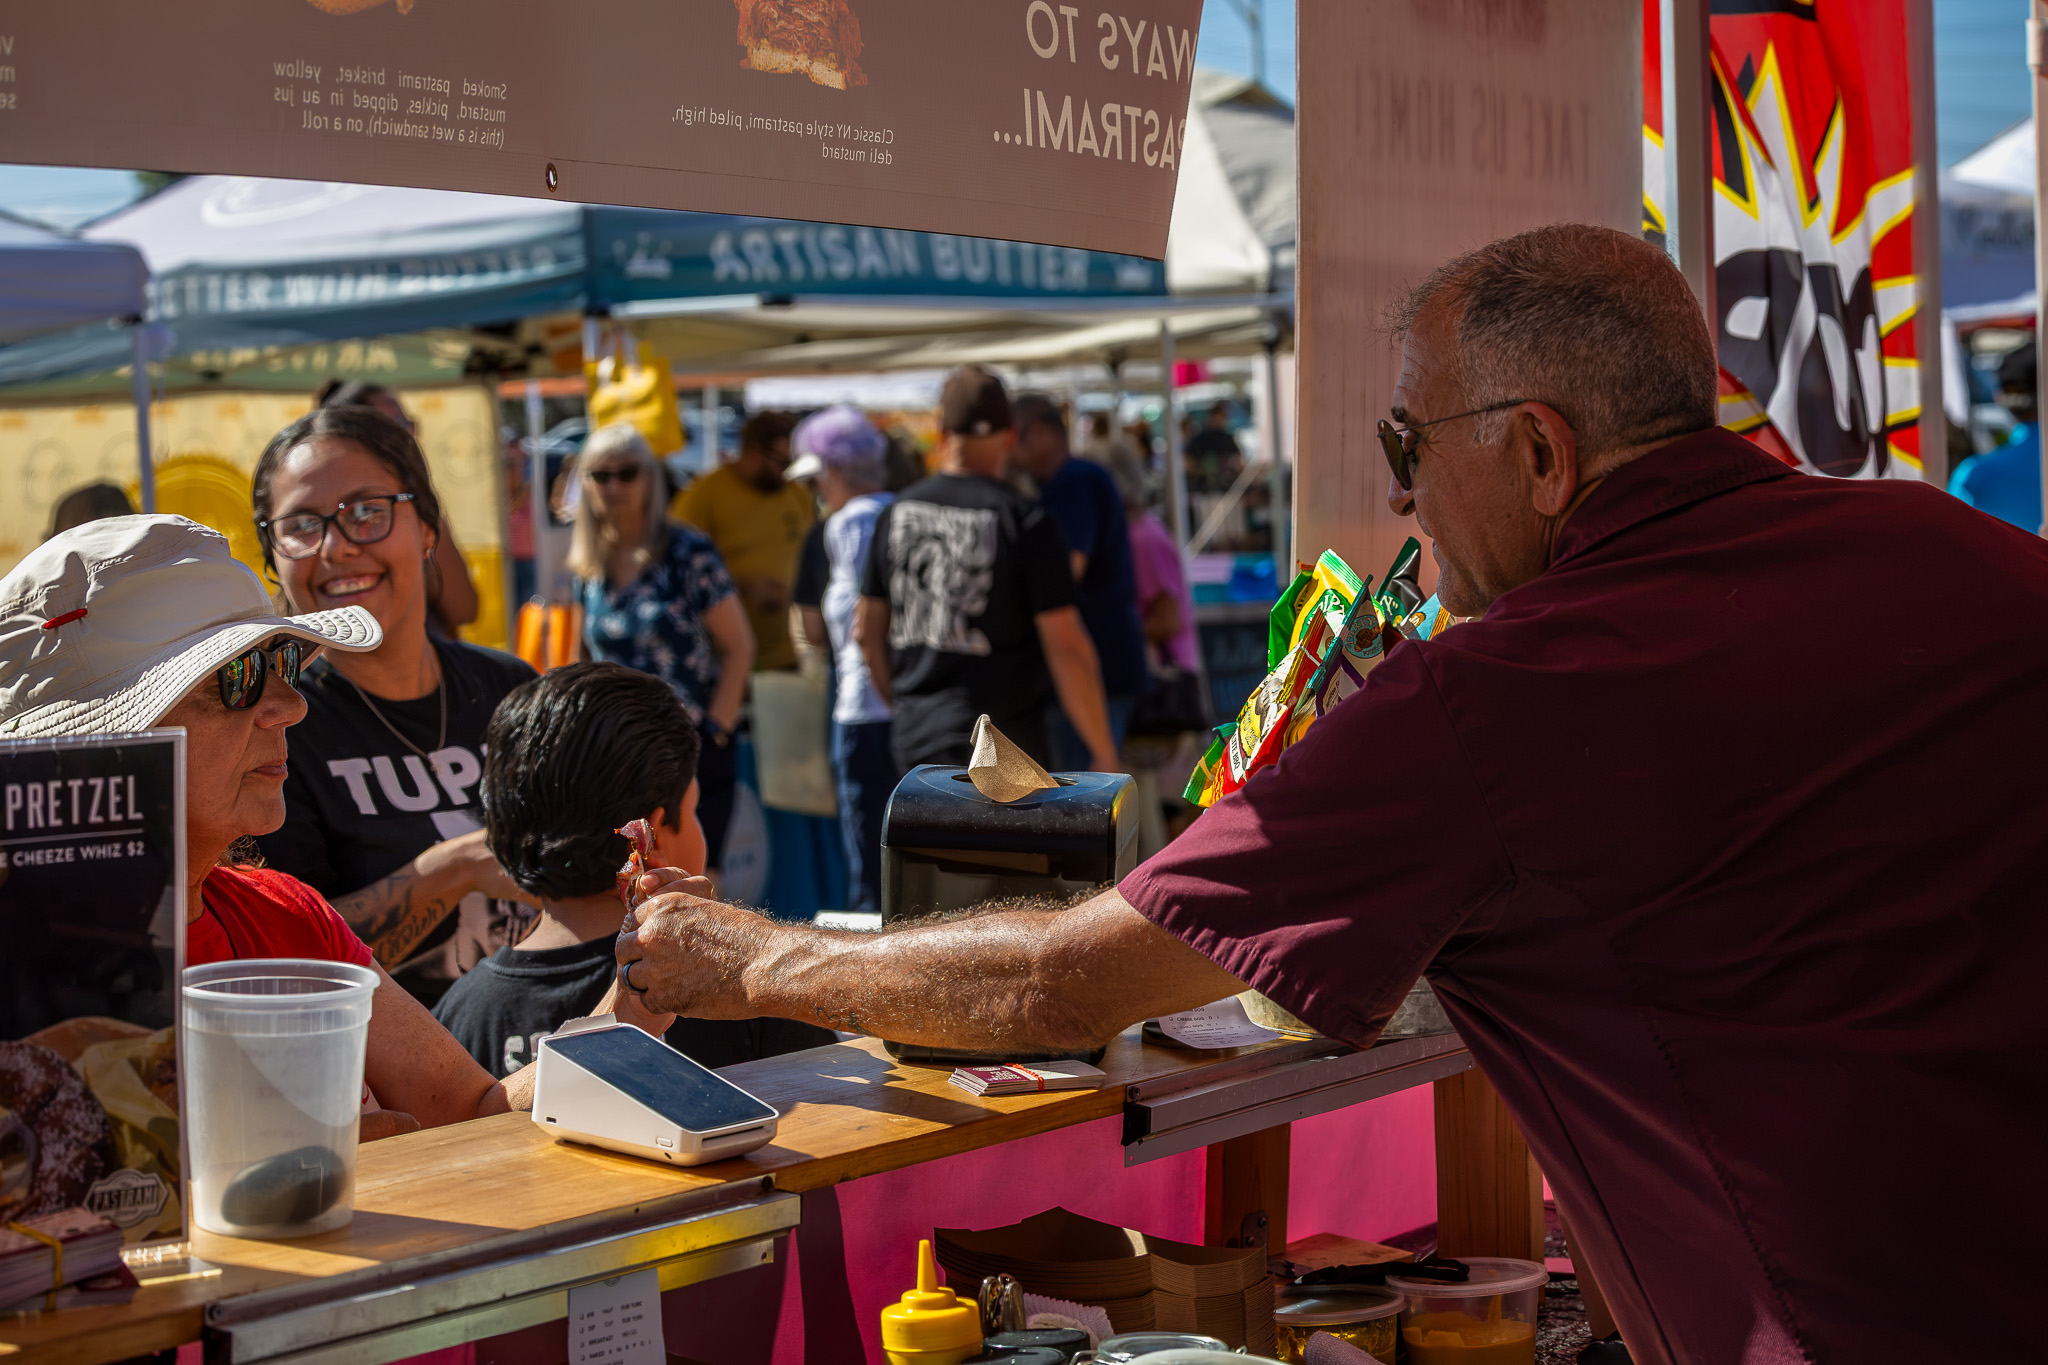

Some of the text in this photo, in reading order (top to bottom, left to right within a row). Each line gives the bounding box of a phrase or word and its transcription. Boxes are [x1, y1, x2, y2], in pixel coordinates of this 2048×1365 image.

[709, 225, 920, 284] ARTISAN
[5, 774, 144, 831] PRETZEL
[326, 744, 489, 815] TUP
[12, 847, 75, 867] CHEEZE
[80, 842, 122, 860] WHIZ
[127, 840, 145, 857] $2
